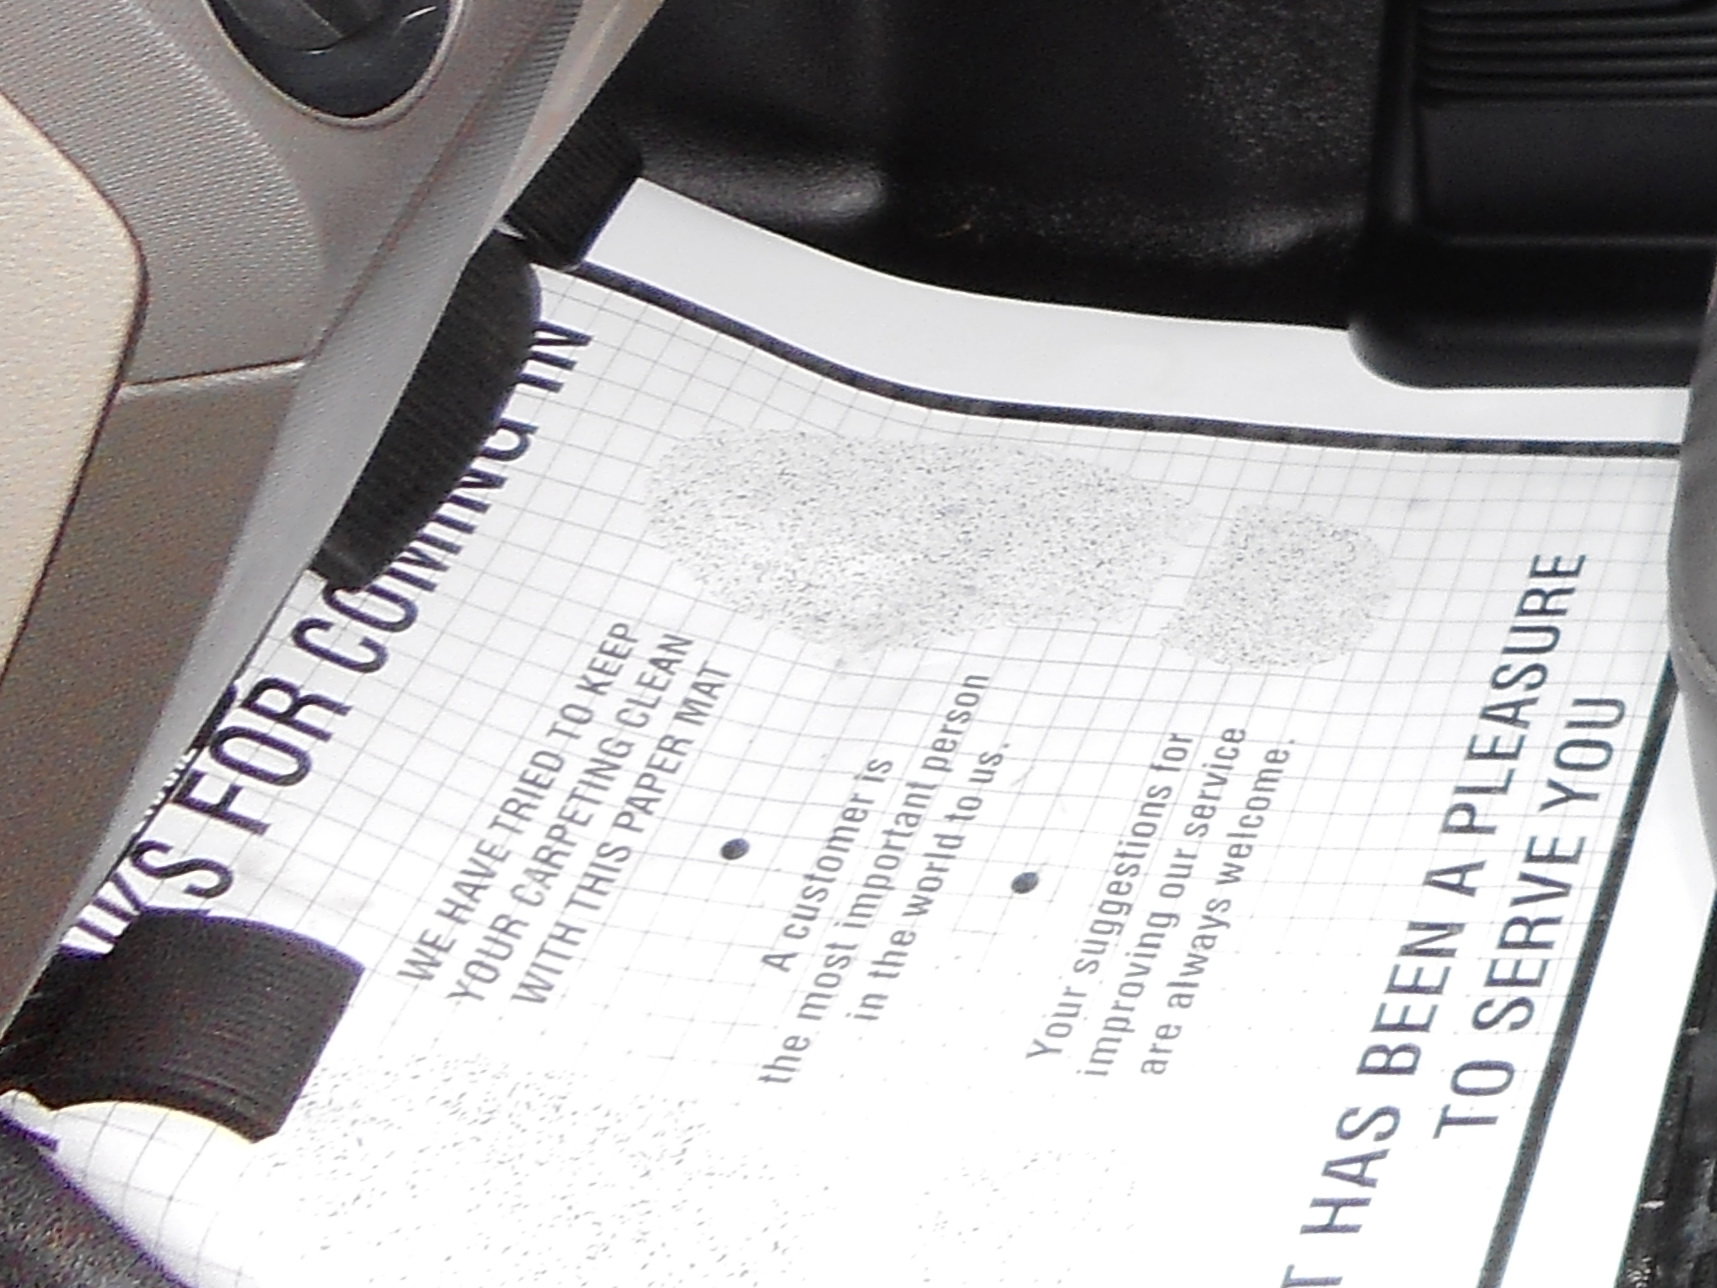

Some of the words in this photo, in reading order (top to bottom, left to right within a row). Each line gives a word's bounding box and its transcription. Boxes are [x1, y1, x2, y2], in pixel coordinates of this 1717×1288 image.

[172, 677, 353, 836] FOR
[396, 928, 457, 982] WE
[434, 838, 511, 926] HAVE
[488, 749, 565, 835] TRIED
[546, 702, 594, 741] TO
[576, 622, 639, 697] KEEP
[446, 912, 530, 1002] YOUR
[509, 737, 635, 908] CARPETING
[615, 633, 694, 729] CLEAN
[511, 920, 588, 1005] WITH
[565, 841, 632, 911] THIS
[612, 734, 693, 833] PAPER
[673, 660, 732, 726] MAT
[1440, 553, 1588, 836] PLEASURE
[1538, 697, 1627, 813] YOU
[757, 1034, 811, 1085] the
[797, 941, 859, 1021] most
[835, 780, 938, 929] important
[920, 673, 991, 774] person
[761, 952, 799, 973] A
[783, 793, 876, 941] customer
[854, 758, 895, 784] is
[845, 991, 889, 1021] in
[867, 930, 917, 979] the
[902, 833, 966, 918] world
[944, 795, 984, 824] to
[968, 742, 1011, 784] us.
[1024, 986, 1088, 1060] Your
[1072, 784, 1174, 975] suggestions
[1149, 732, 1194, 773] for
[1075, 912, 1181, 1076] improving
[1158, 847, 1198, 899] our
[1183, 727, 1247, 838] service
[1140, 1023, 1183, 1076] are
[1165, 897, 1232, 1010] always
[1215, 738, 1296, 886] welcome.
[1355, 921, 1467, 1076] BEEN
[1422, 860, 1488, 897] A
[1471, 835, 1588, 1032] SERVE
[1299, 1105, 1401, 1235] HAS
[1433, 1059, 1516, 1139] TO
